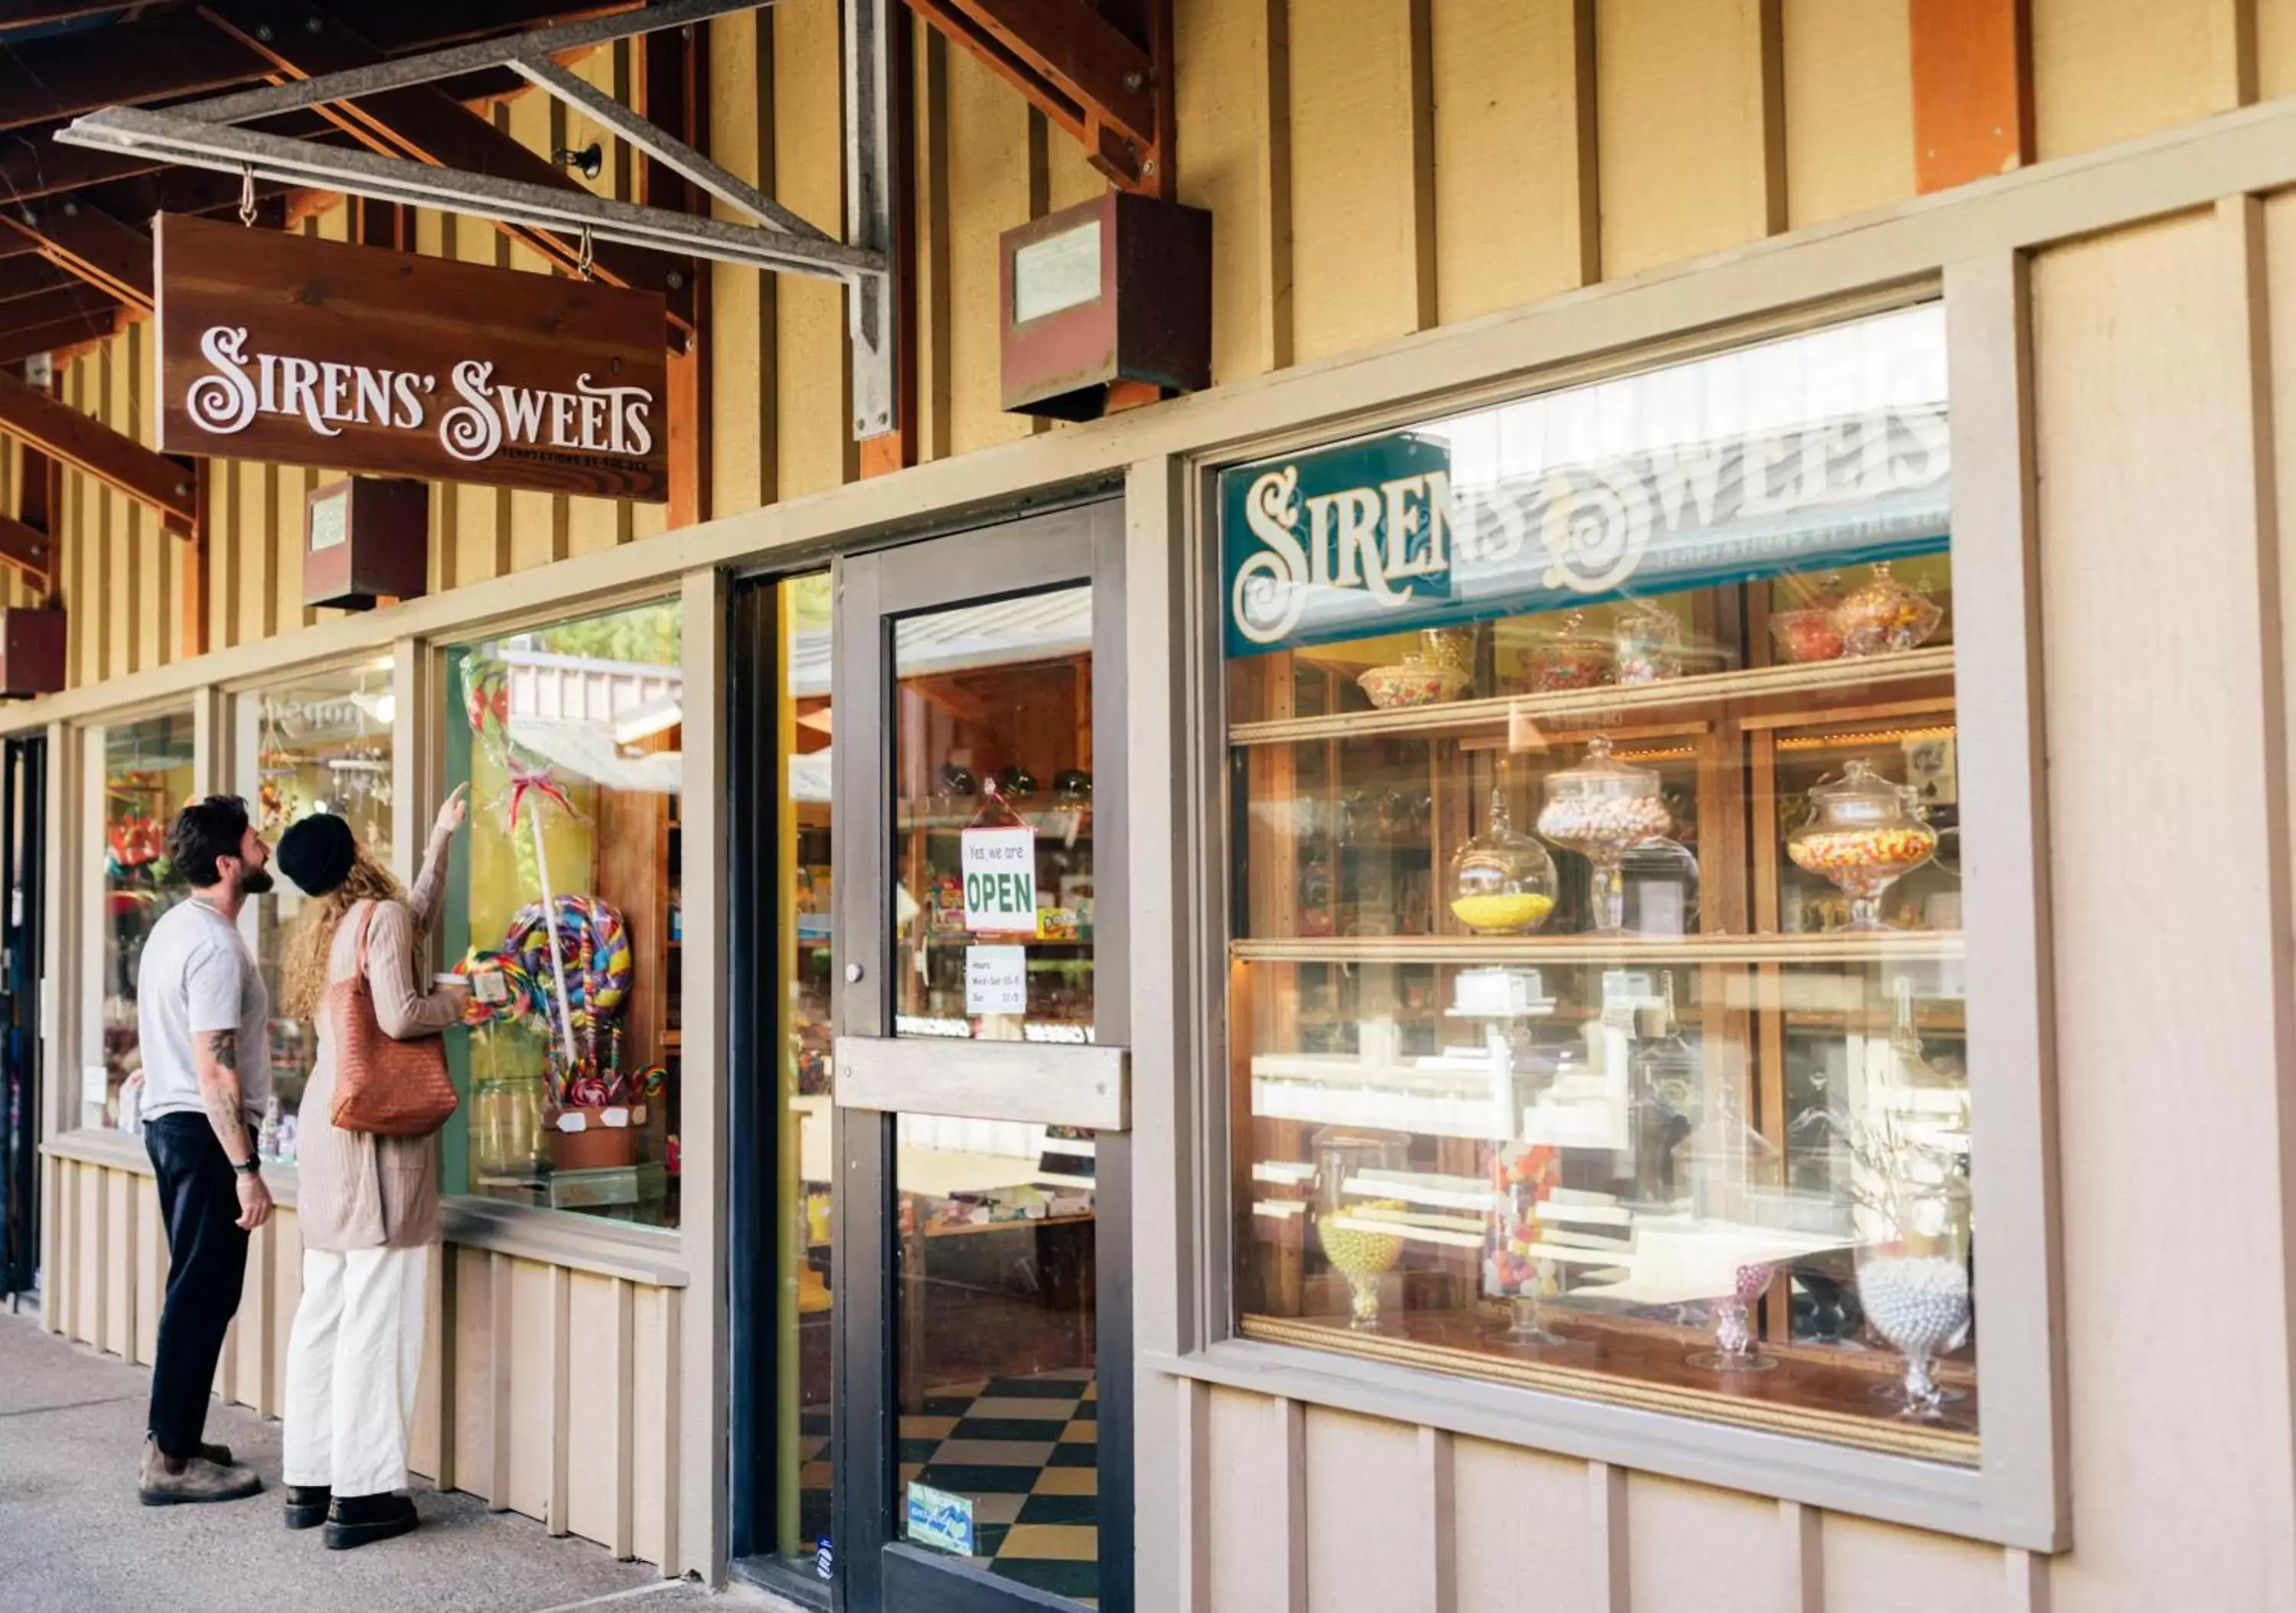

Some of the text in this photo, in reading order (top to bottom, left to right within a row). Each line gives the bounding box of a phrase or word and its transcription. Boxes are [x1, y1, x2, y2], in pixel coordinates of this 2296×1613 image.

[440, 360, 653, 461] SWEETS
[989, 847, 1003, 859] we
[1005, 846, 1024, 859] are
[967, 872, 1032, 913] OPEN
